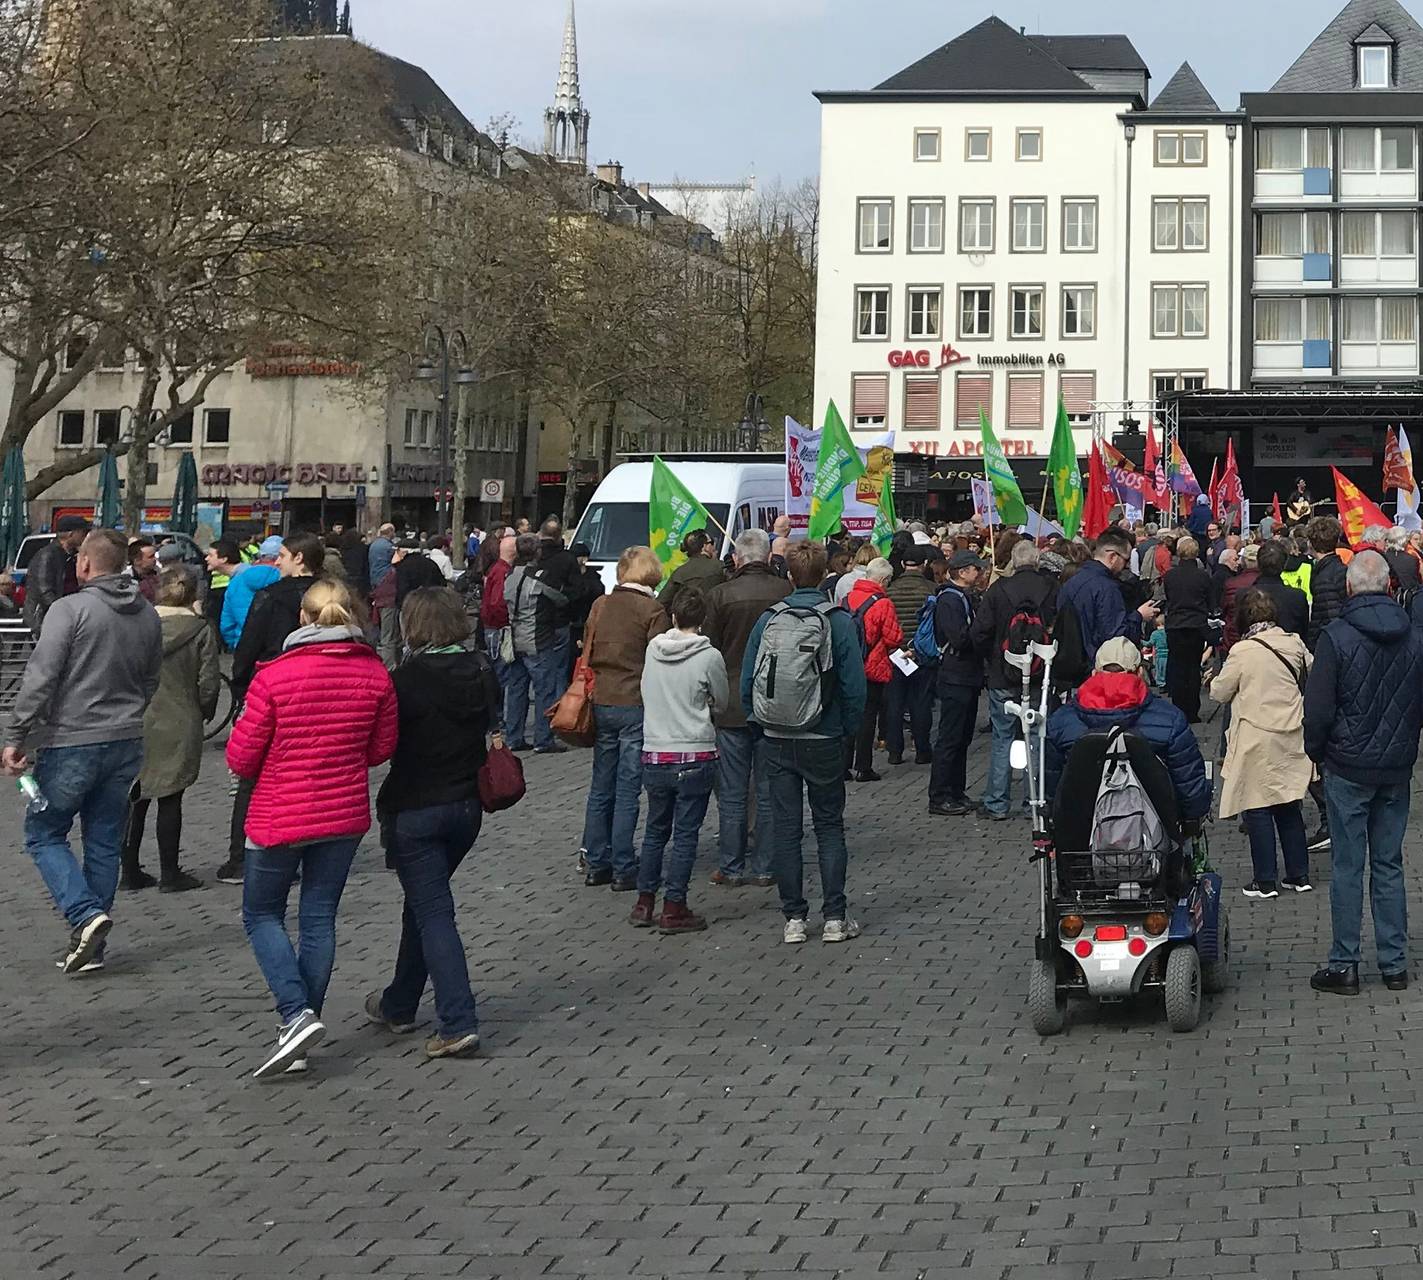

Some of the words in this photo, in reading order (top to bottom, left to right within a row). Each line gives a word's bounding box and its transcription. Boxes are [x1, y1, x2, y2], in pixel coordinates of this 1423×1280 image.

[888, 350, 930, 367] GAG
[977, 353, 1043, 366] Immobilien
[1047, 353, 1065, 365] AG
[909, 440, 939, 456] XII
[946, 440, 1037, 456] APOTEL
